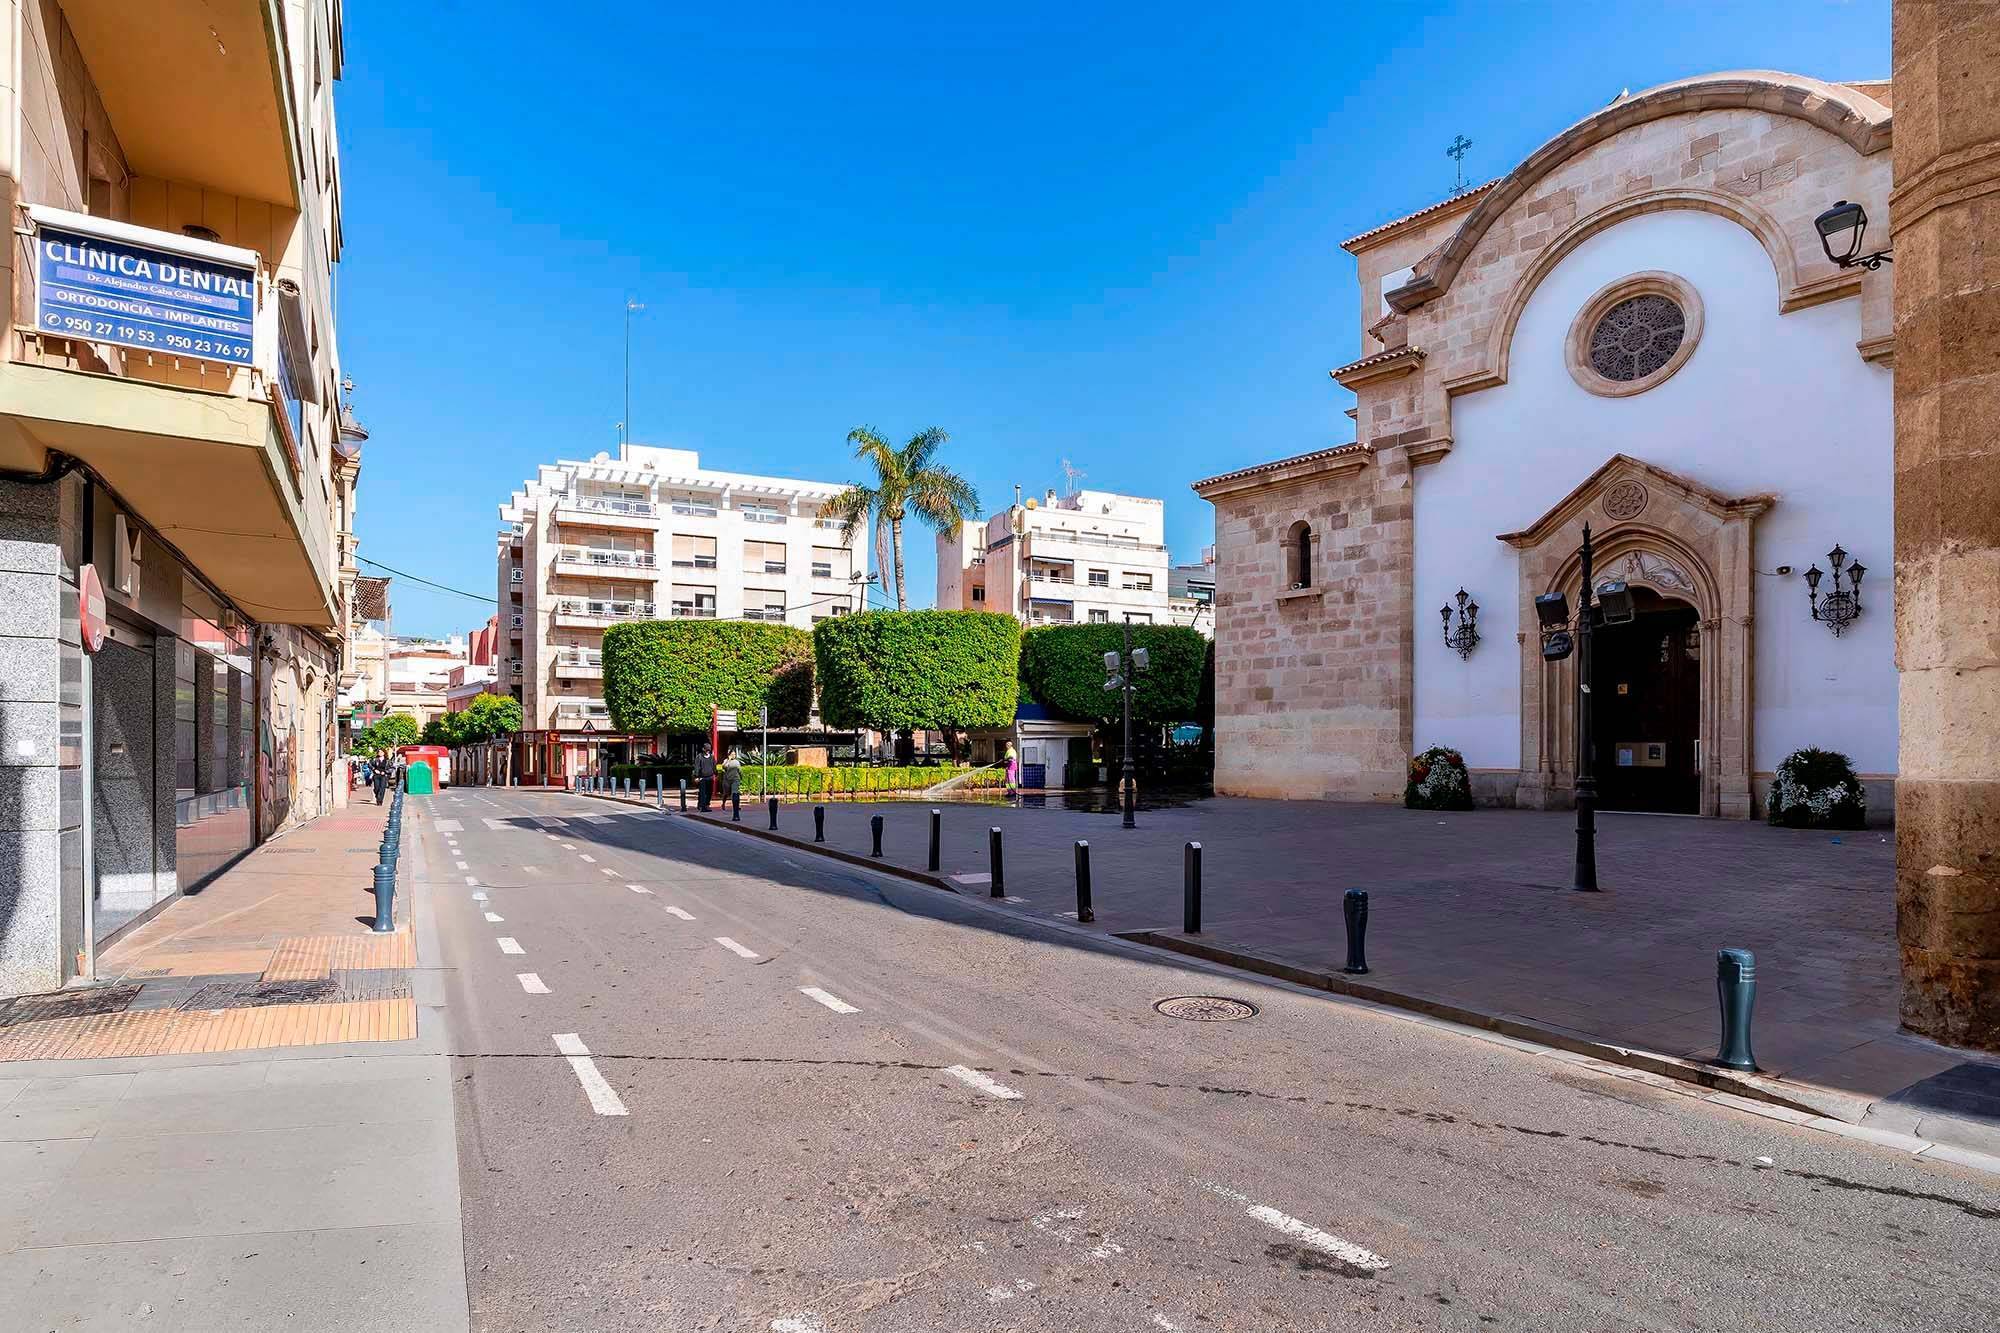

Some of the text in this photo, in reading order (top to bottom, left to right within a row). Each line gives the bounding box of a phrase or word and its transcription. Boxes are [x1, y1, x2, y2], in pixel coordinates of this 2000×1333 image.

[46, 240, 252, 298] CLÍNICA DENTAL
[104, 276, 148, 291] Alejandro
[56, 290, 153, 316] ORTODONCIA
[165, 310, 240, 332] IMPLANTES
[65, 317, 92, 331] 950
[95, 322, 113, 335] 27
[118, 326, 134, 339] 19
[138, 330, 155, 342] 53
[166, 334, 191, 348] 950
[195, 339, 211, 352] 23
[214, 343, 231, 356] 76
[234, 346, 249, 359] 97
